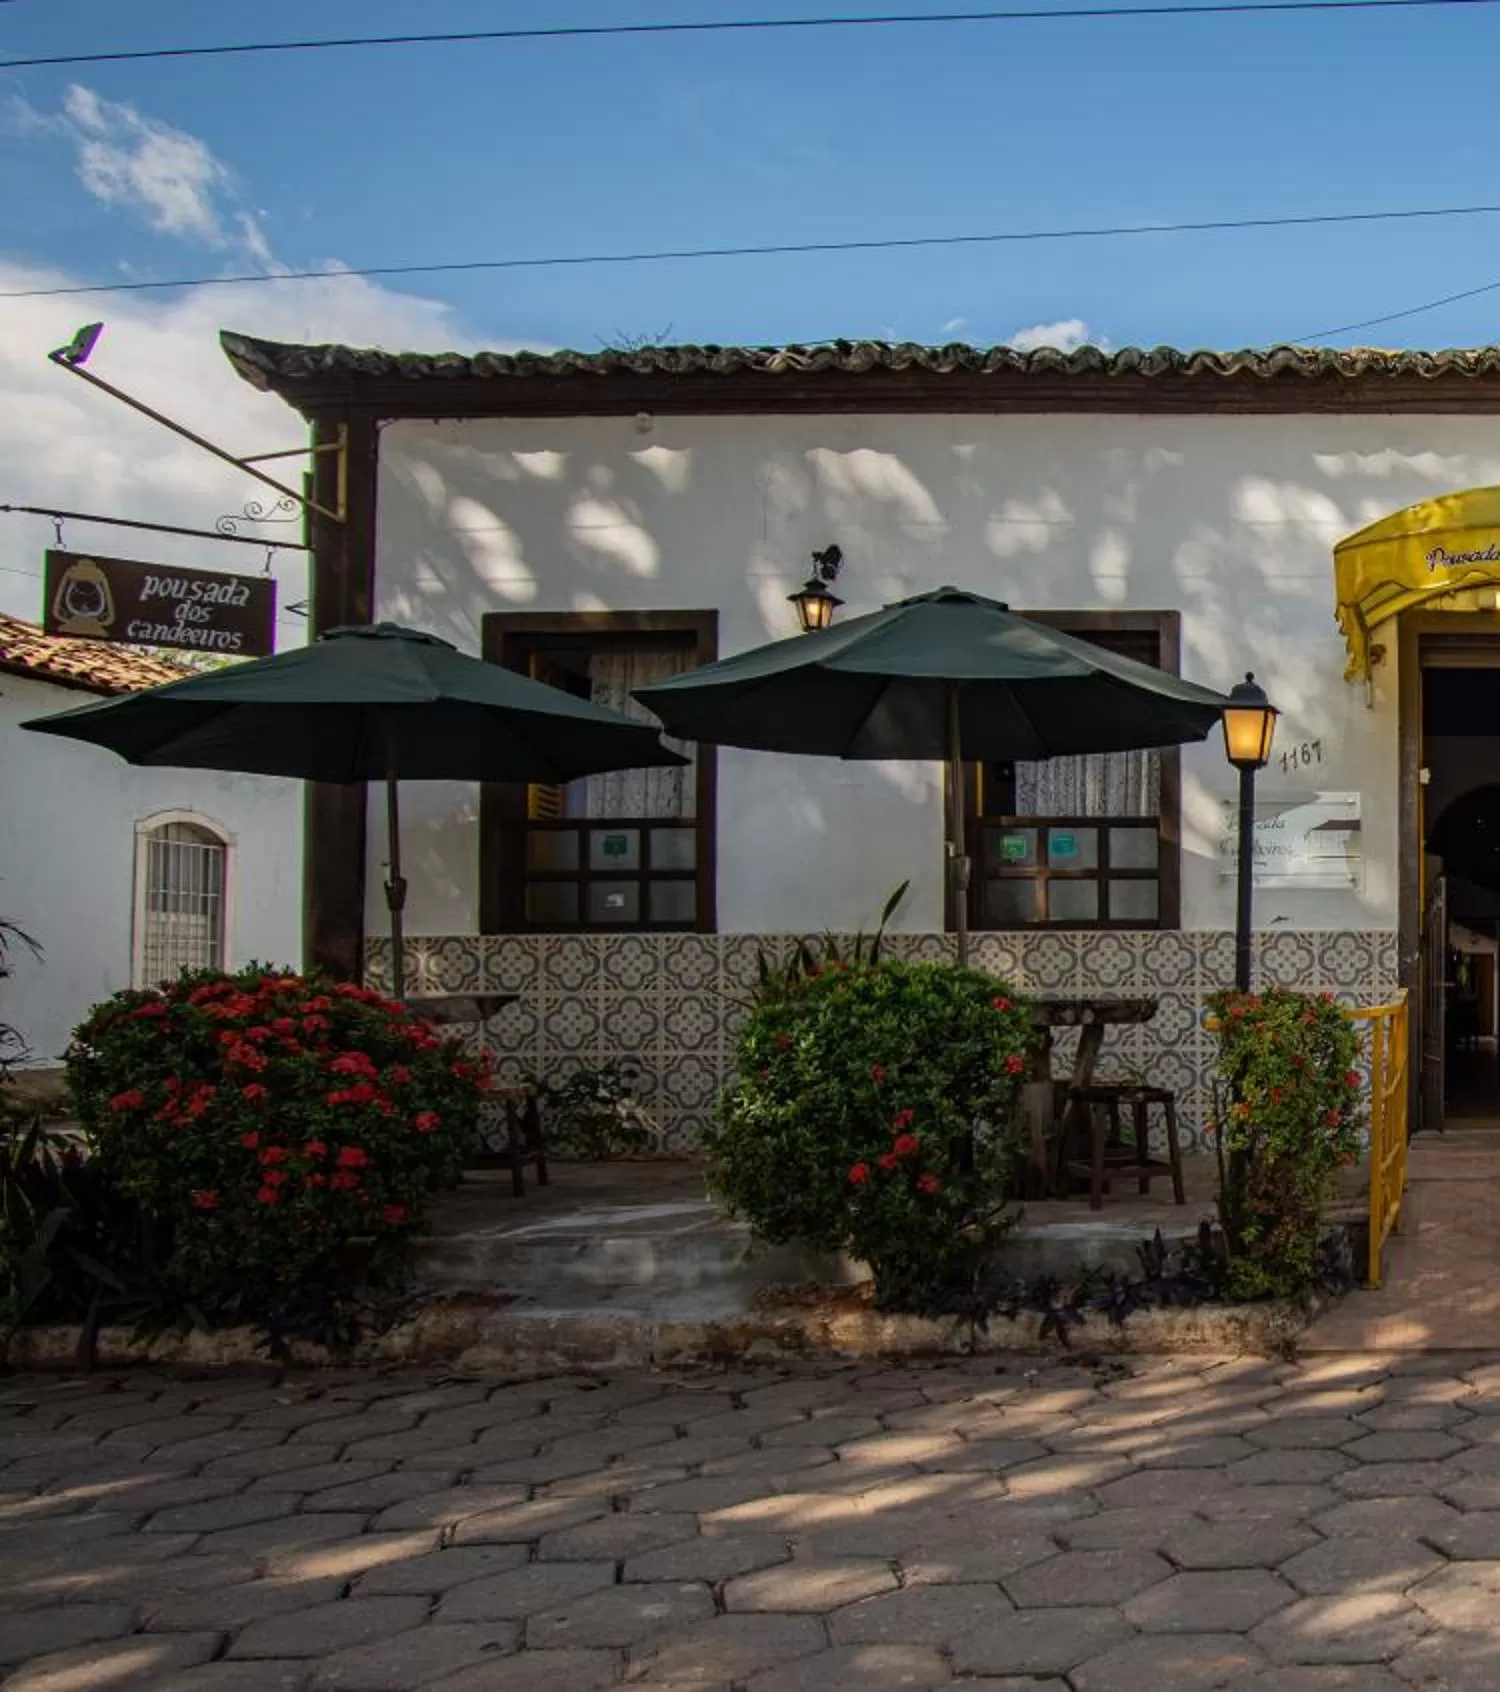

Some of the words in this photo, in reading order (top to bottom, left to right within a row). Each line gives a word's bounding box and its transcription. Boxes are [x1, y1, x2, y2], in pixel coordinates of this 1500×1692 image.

[1426, 546, 1500, 572] Pousada
[139, 576, 250, 606] pousada
[175, 600, 214, 622] dos
[127, 620, 244, 649] candeeiros
